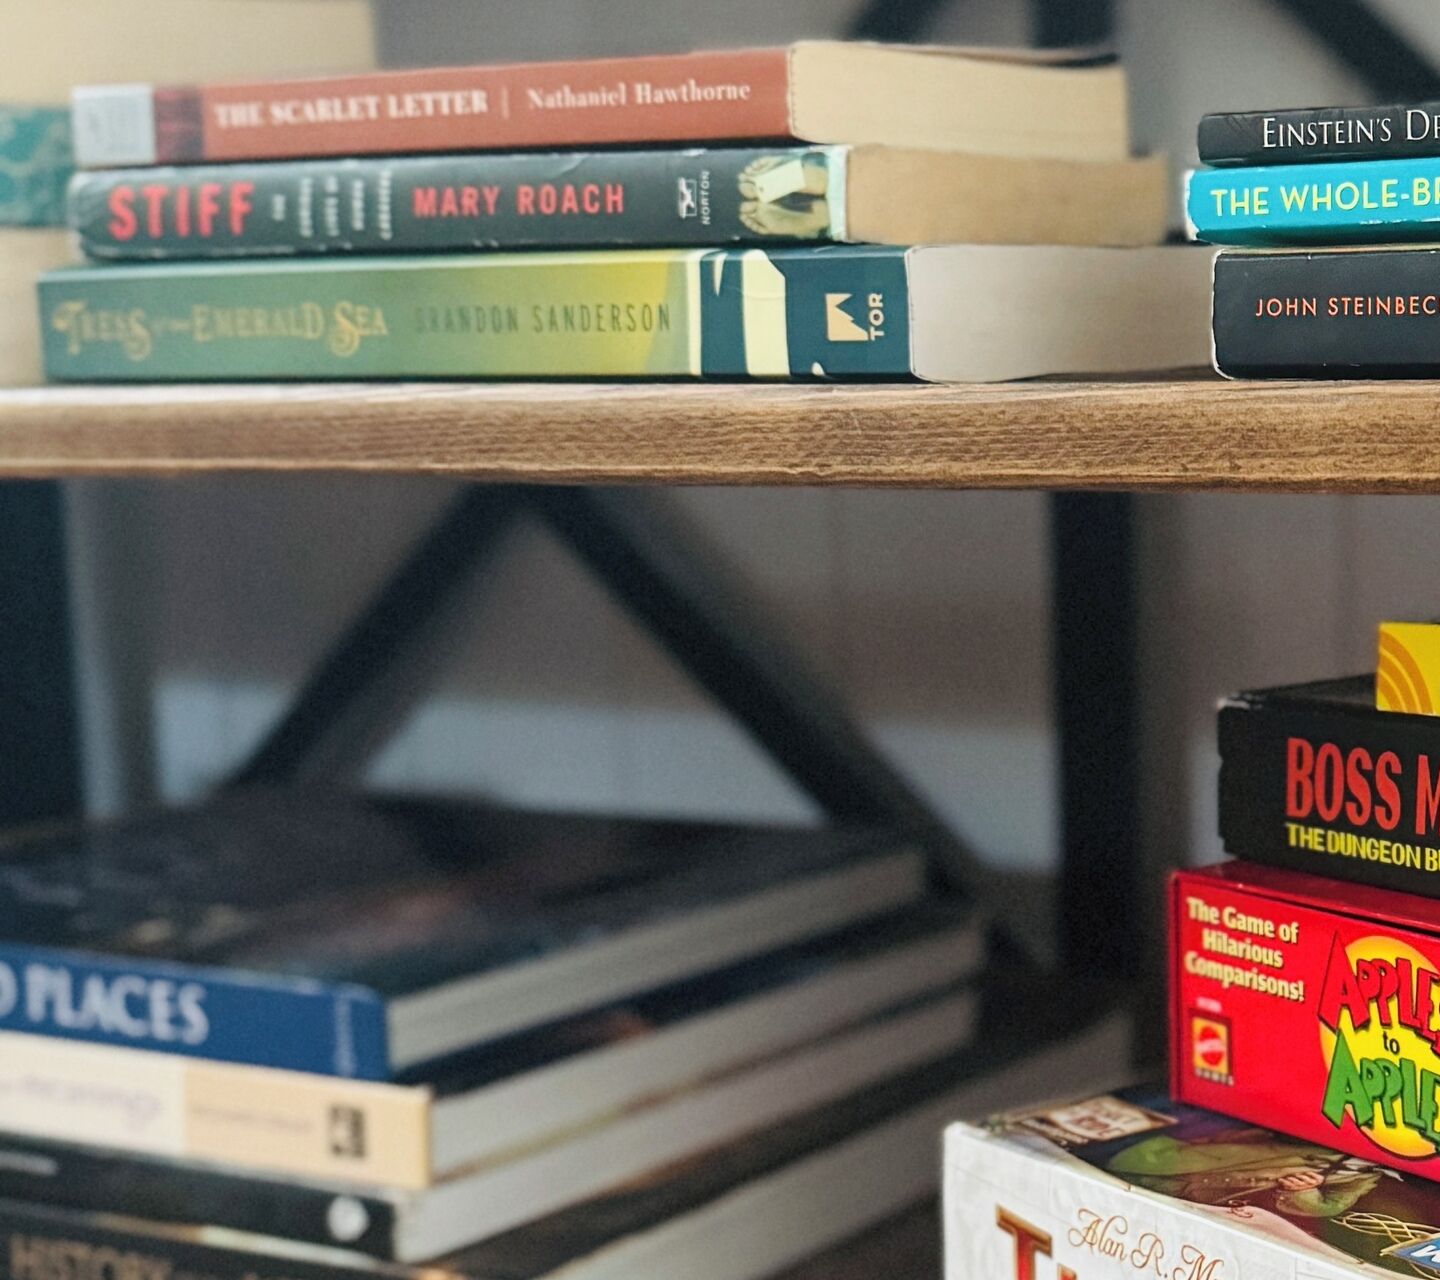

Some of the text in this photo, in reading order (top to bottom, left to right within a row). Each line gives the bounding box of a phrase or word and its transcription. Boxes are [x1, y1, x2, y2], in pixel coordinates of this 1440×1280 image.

[215, 81, 751, 129] THE SCARLET LETTER Nathaniel Hawthorne
[1262, 117, 1391, 148] EINSTEIN'S
[109, 181, 256, 240] STIFF
[413, 185, 499, 218] MARY
[516, 183, 625, 214] ROACH
[702, 171, 710, 225] NORTON
[1210, 186, 1270, 218] THE
[413, 302, 672, 334] BRANDON SANDERSON
[869, 292, 885, 341] TOR
[1255, 296, 1318, 317] JOHN
[1286, 737, 1401, 830] BOSS
[1286, 823, 1326, 851] THE
[1325, 830, 1422, 869] DUNGEON
[1186, 897, 1299, 944] The Game of
[1202, 928, 1284, 968] Hilarious
[1184, 950, 1305, 1002] Comparisons!
[24, 964, 209, 1044] PLACES
[1382, 1031, 1400, 1054] to
[1068, 1209, 1129, 1262] Alan
[1131, 1232, 1170, 1280] R.
